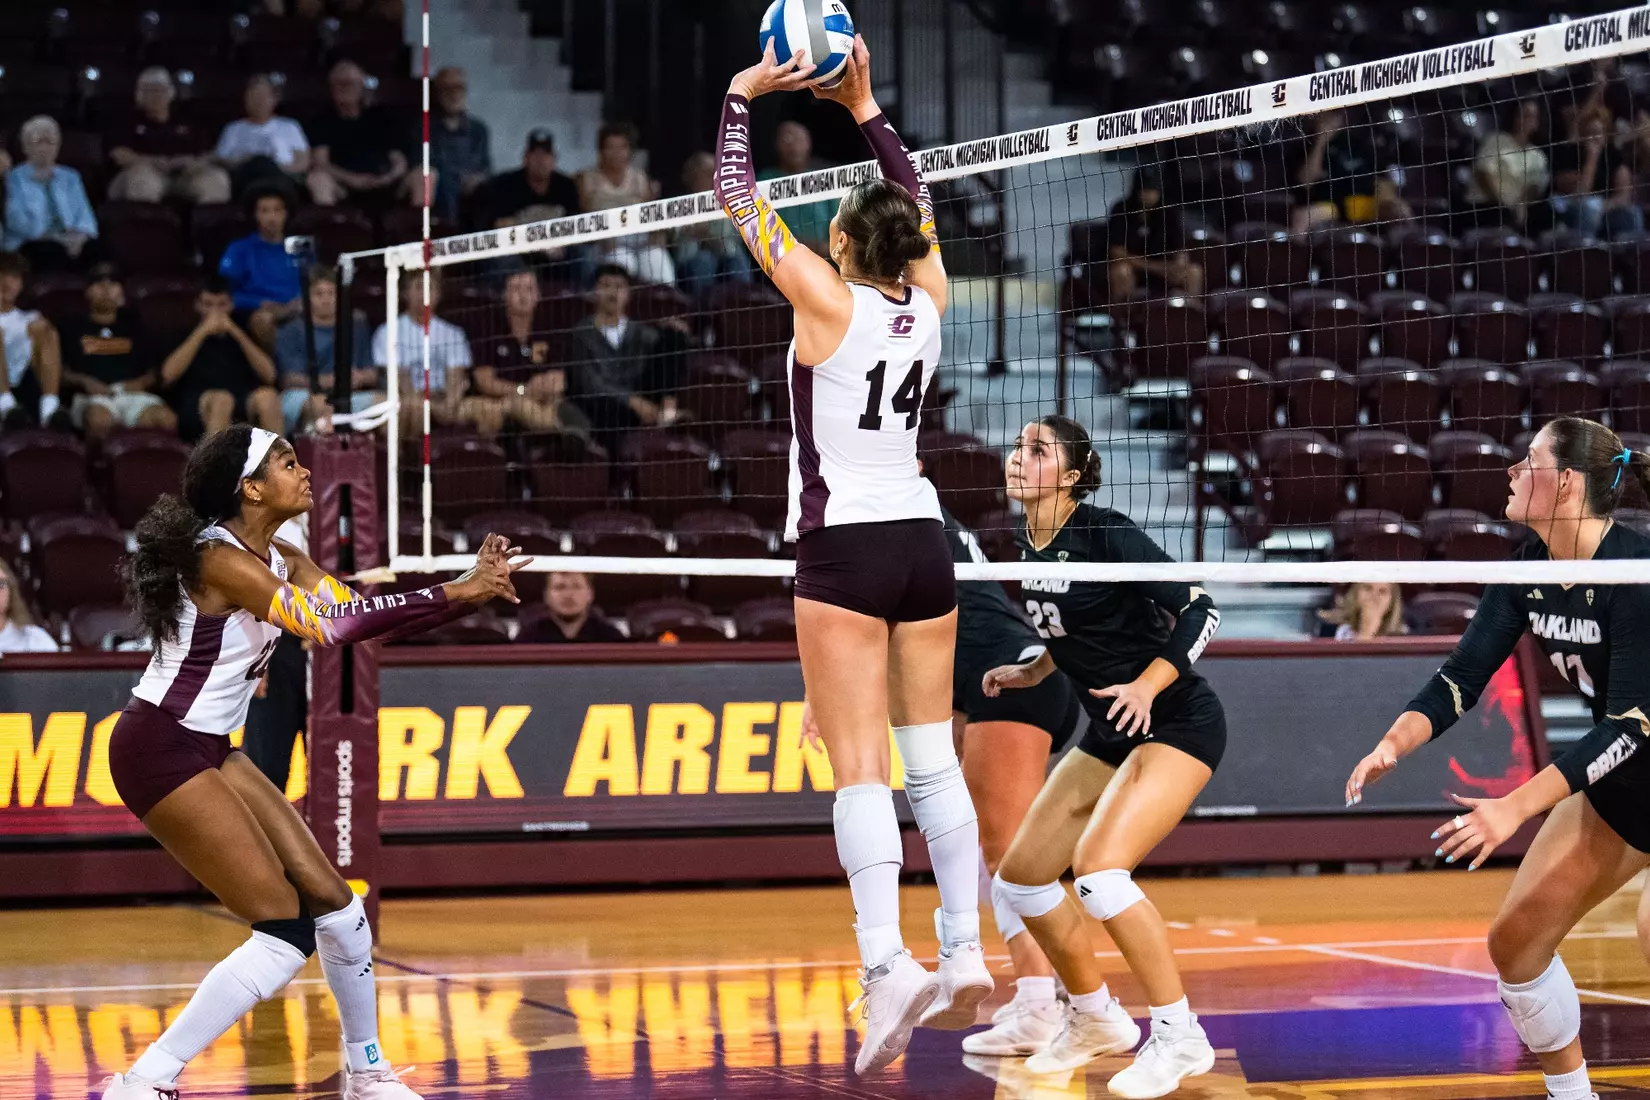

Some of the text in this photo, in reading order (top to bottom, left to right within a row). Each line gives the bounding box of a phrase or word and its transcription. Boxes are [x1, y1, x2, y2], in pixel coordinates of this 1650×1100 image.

[1564, 17, 1622, 52] CENTRAL
[1309, 39, 1495, 101] CENTRAL MICHIGAN VOLLEYBALL
[1096, 89, 1252, 141] CENTRAL MICHIGAN VOLLEYBALL
[720, 123, 760, 226] CHIPPEWAS
[920, 128, 1050, 173] CENTRAL MICHIGAN VOLLEYBALL
[769, 177, 798, 200] CENTRAL
[801, 170, 834, 195] MICHIGAN
[858, 360, 923, 430] 14
[563, 701, 904, 798] AREN
[334, 740, 354, 867] sports imports
